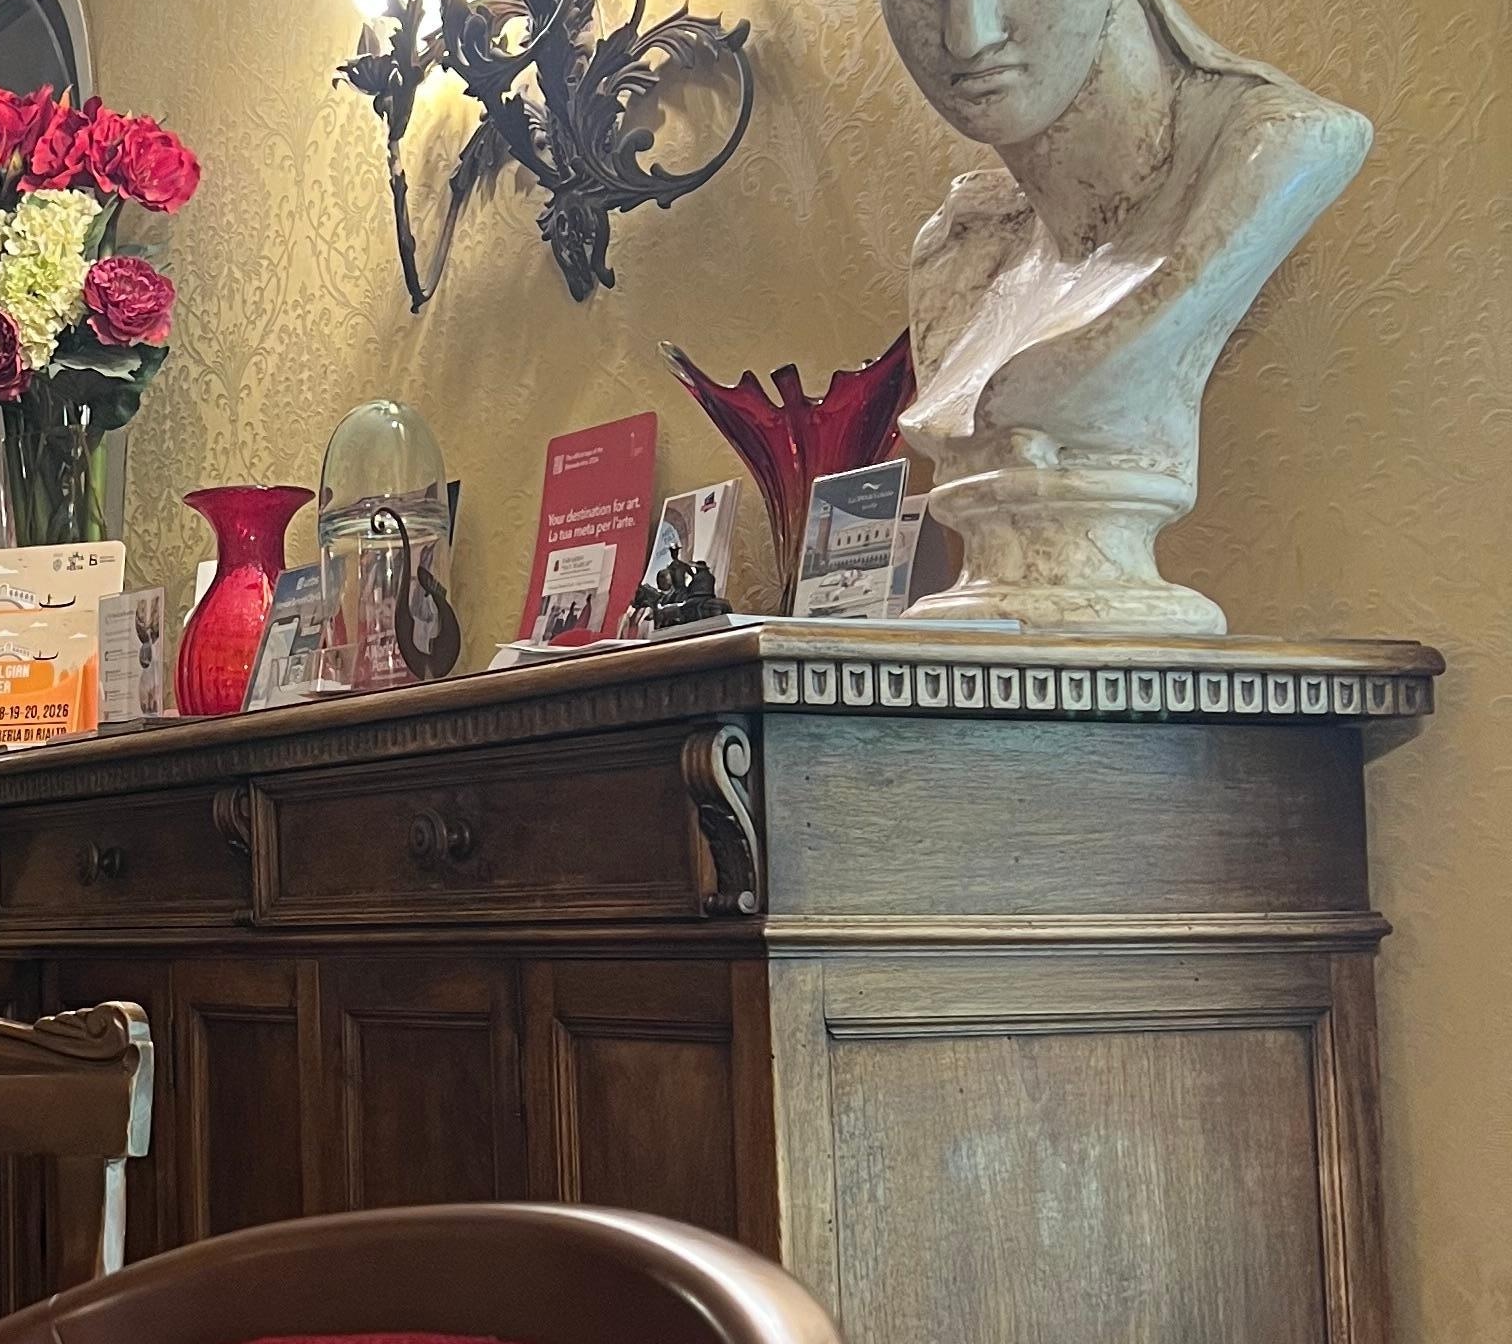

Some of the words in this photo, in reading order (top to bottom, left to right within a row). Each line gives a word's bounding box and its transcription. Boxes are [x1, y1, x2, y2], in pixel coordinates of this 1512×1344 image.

[548, 514, 565, 526] Your
[566, 505, 611, 523] destination
[613, 498, 625, 513] for
[548, 530, 558, 543] La
[559, 528, 573, 541] tua
[573, 523, 595, 538] meta
[595, 520, 611, 538] per
[42, 703, 69, 719] 2026
[23, 728, 34, 742] DI
